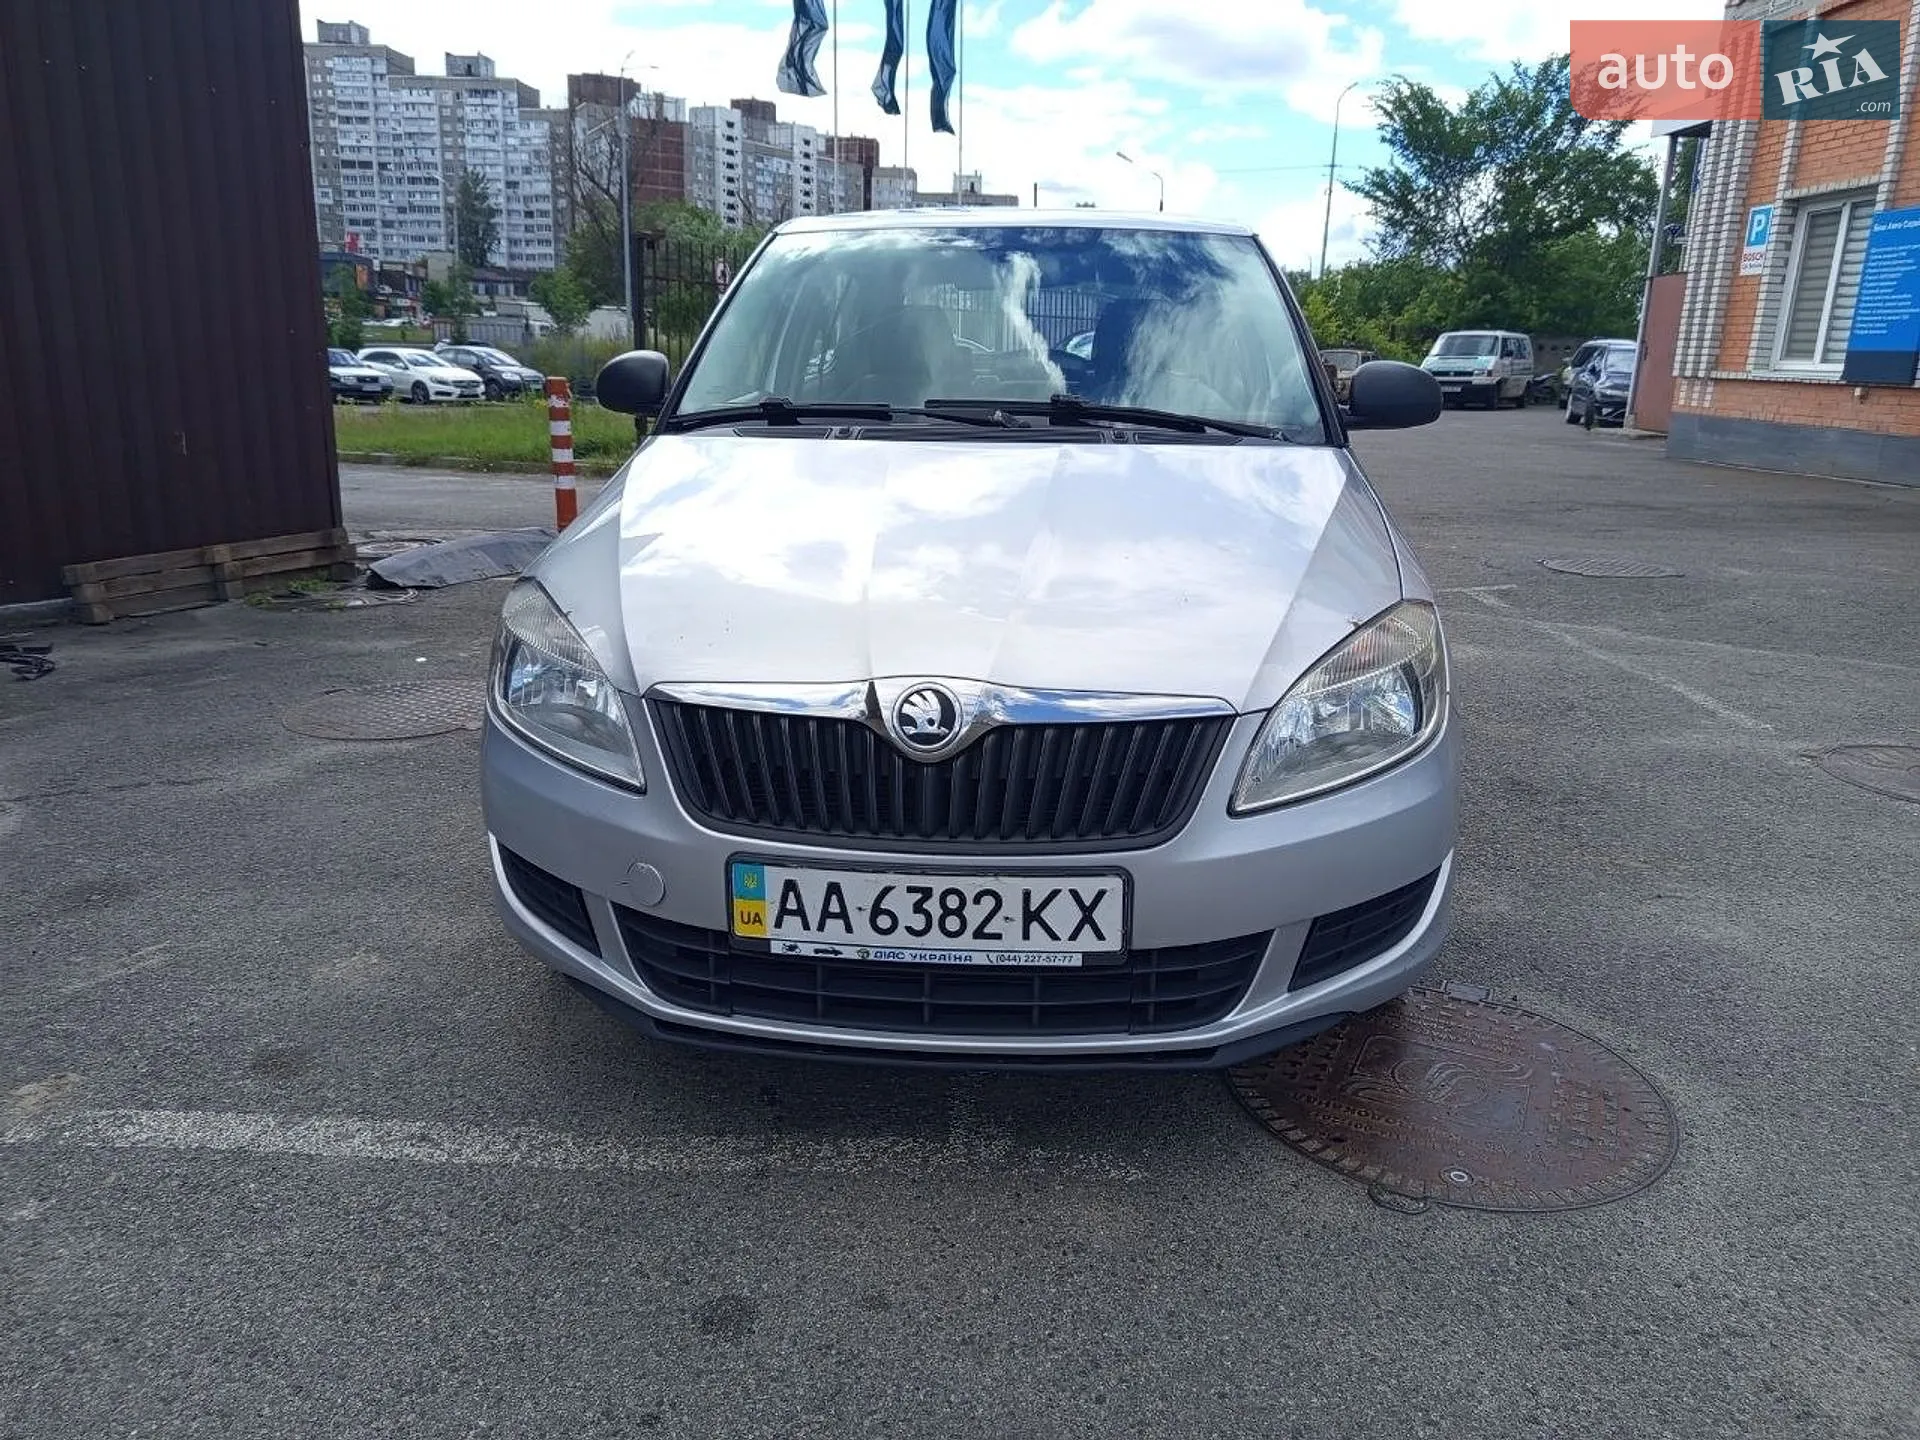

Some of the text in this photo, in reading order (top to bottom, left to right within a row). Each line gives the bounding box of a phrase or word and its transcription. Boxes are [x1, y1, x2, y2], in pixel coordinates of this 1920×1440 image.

[740, 879, 1109, 941] UA AA 6382 KX
[910, 952, 973, 963] УКРАЇНА
[995, 953, 1022, 964] (044)
[1023, 954, 1075, 964] 227-57-77
